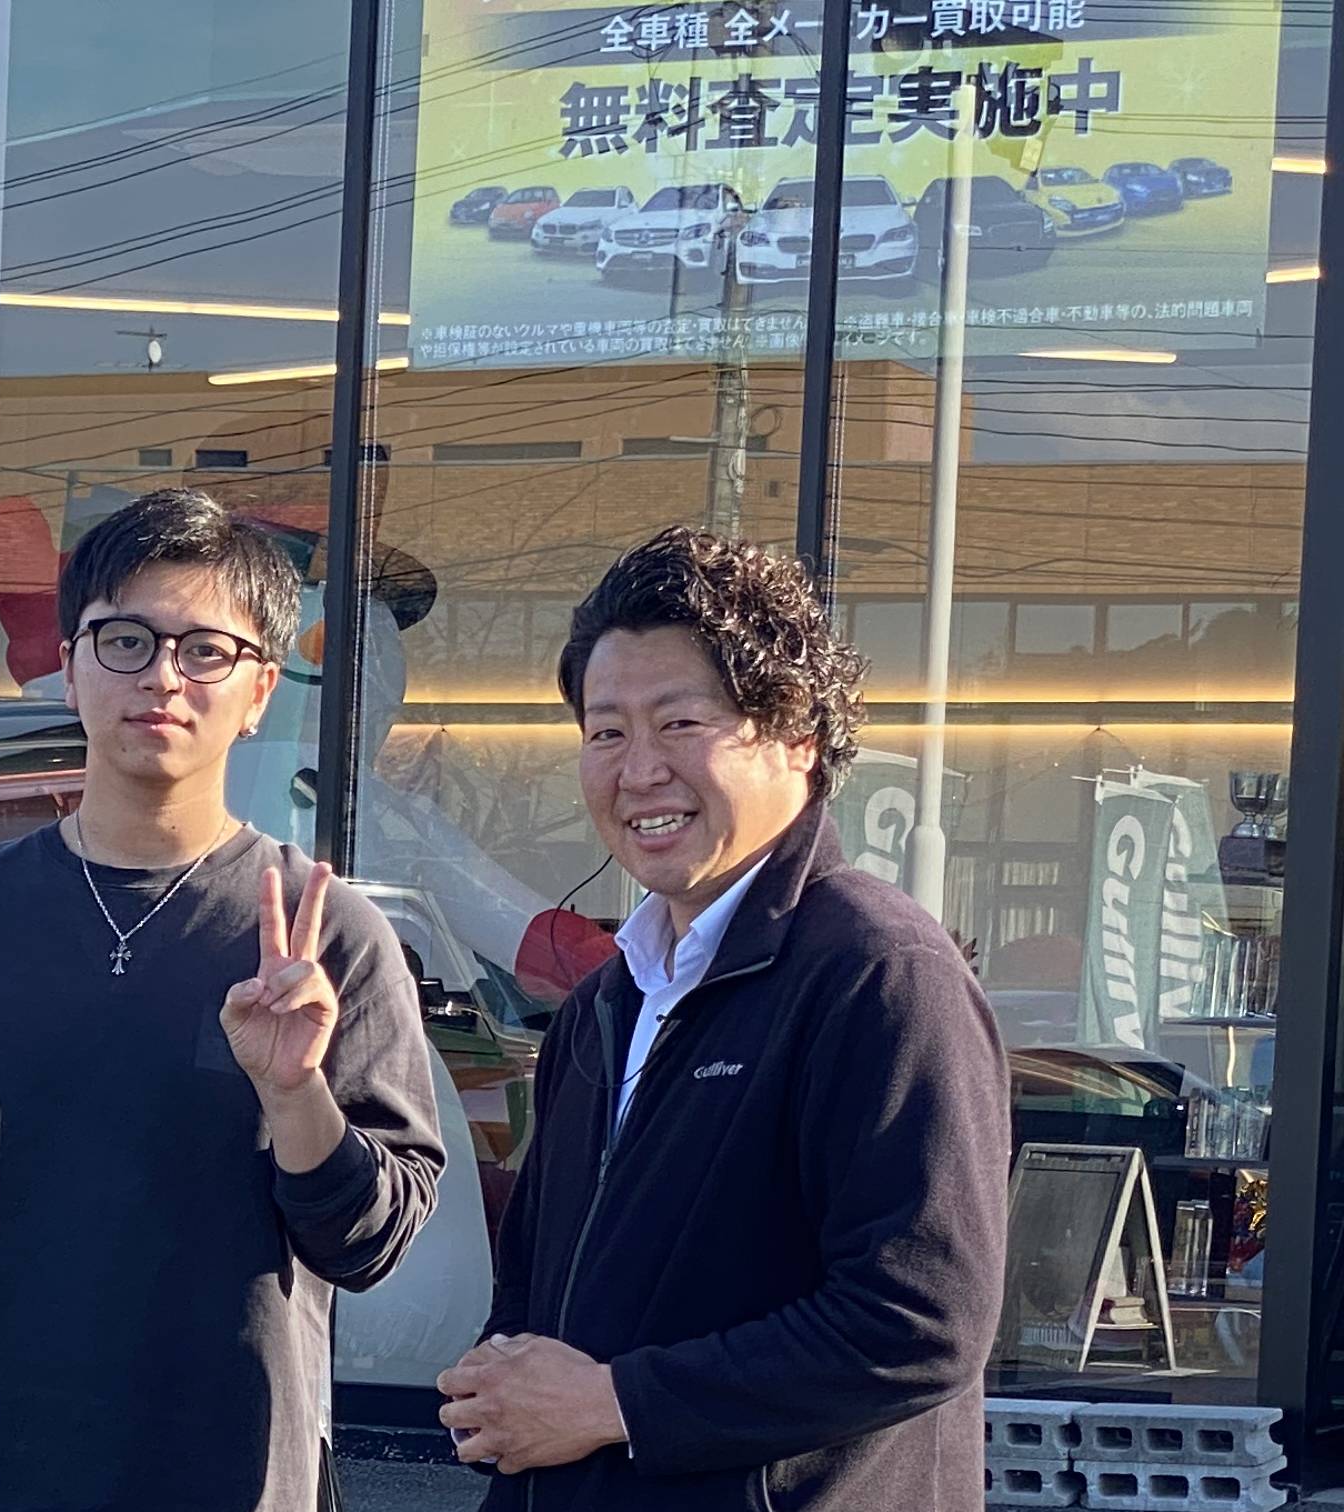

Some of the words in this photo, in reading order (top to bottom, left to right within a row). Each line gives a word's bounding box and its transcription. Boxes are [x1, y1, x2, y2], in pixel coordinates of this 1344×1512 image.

[600, 12, 709, 53] 全車種
[558, 56, 1123, 160] 無料査定実施中
[693, 1060, 744, 1080] Gulliver
